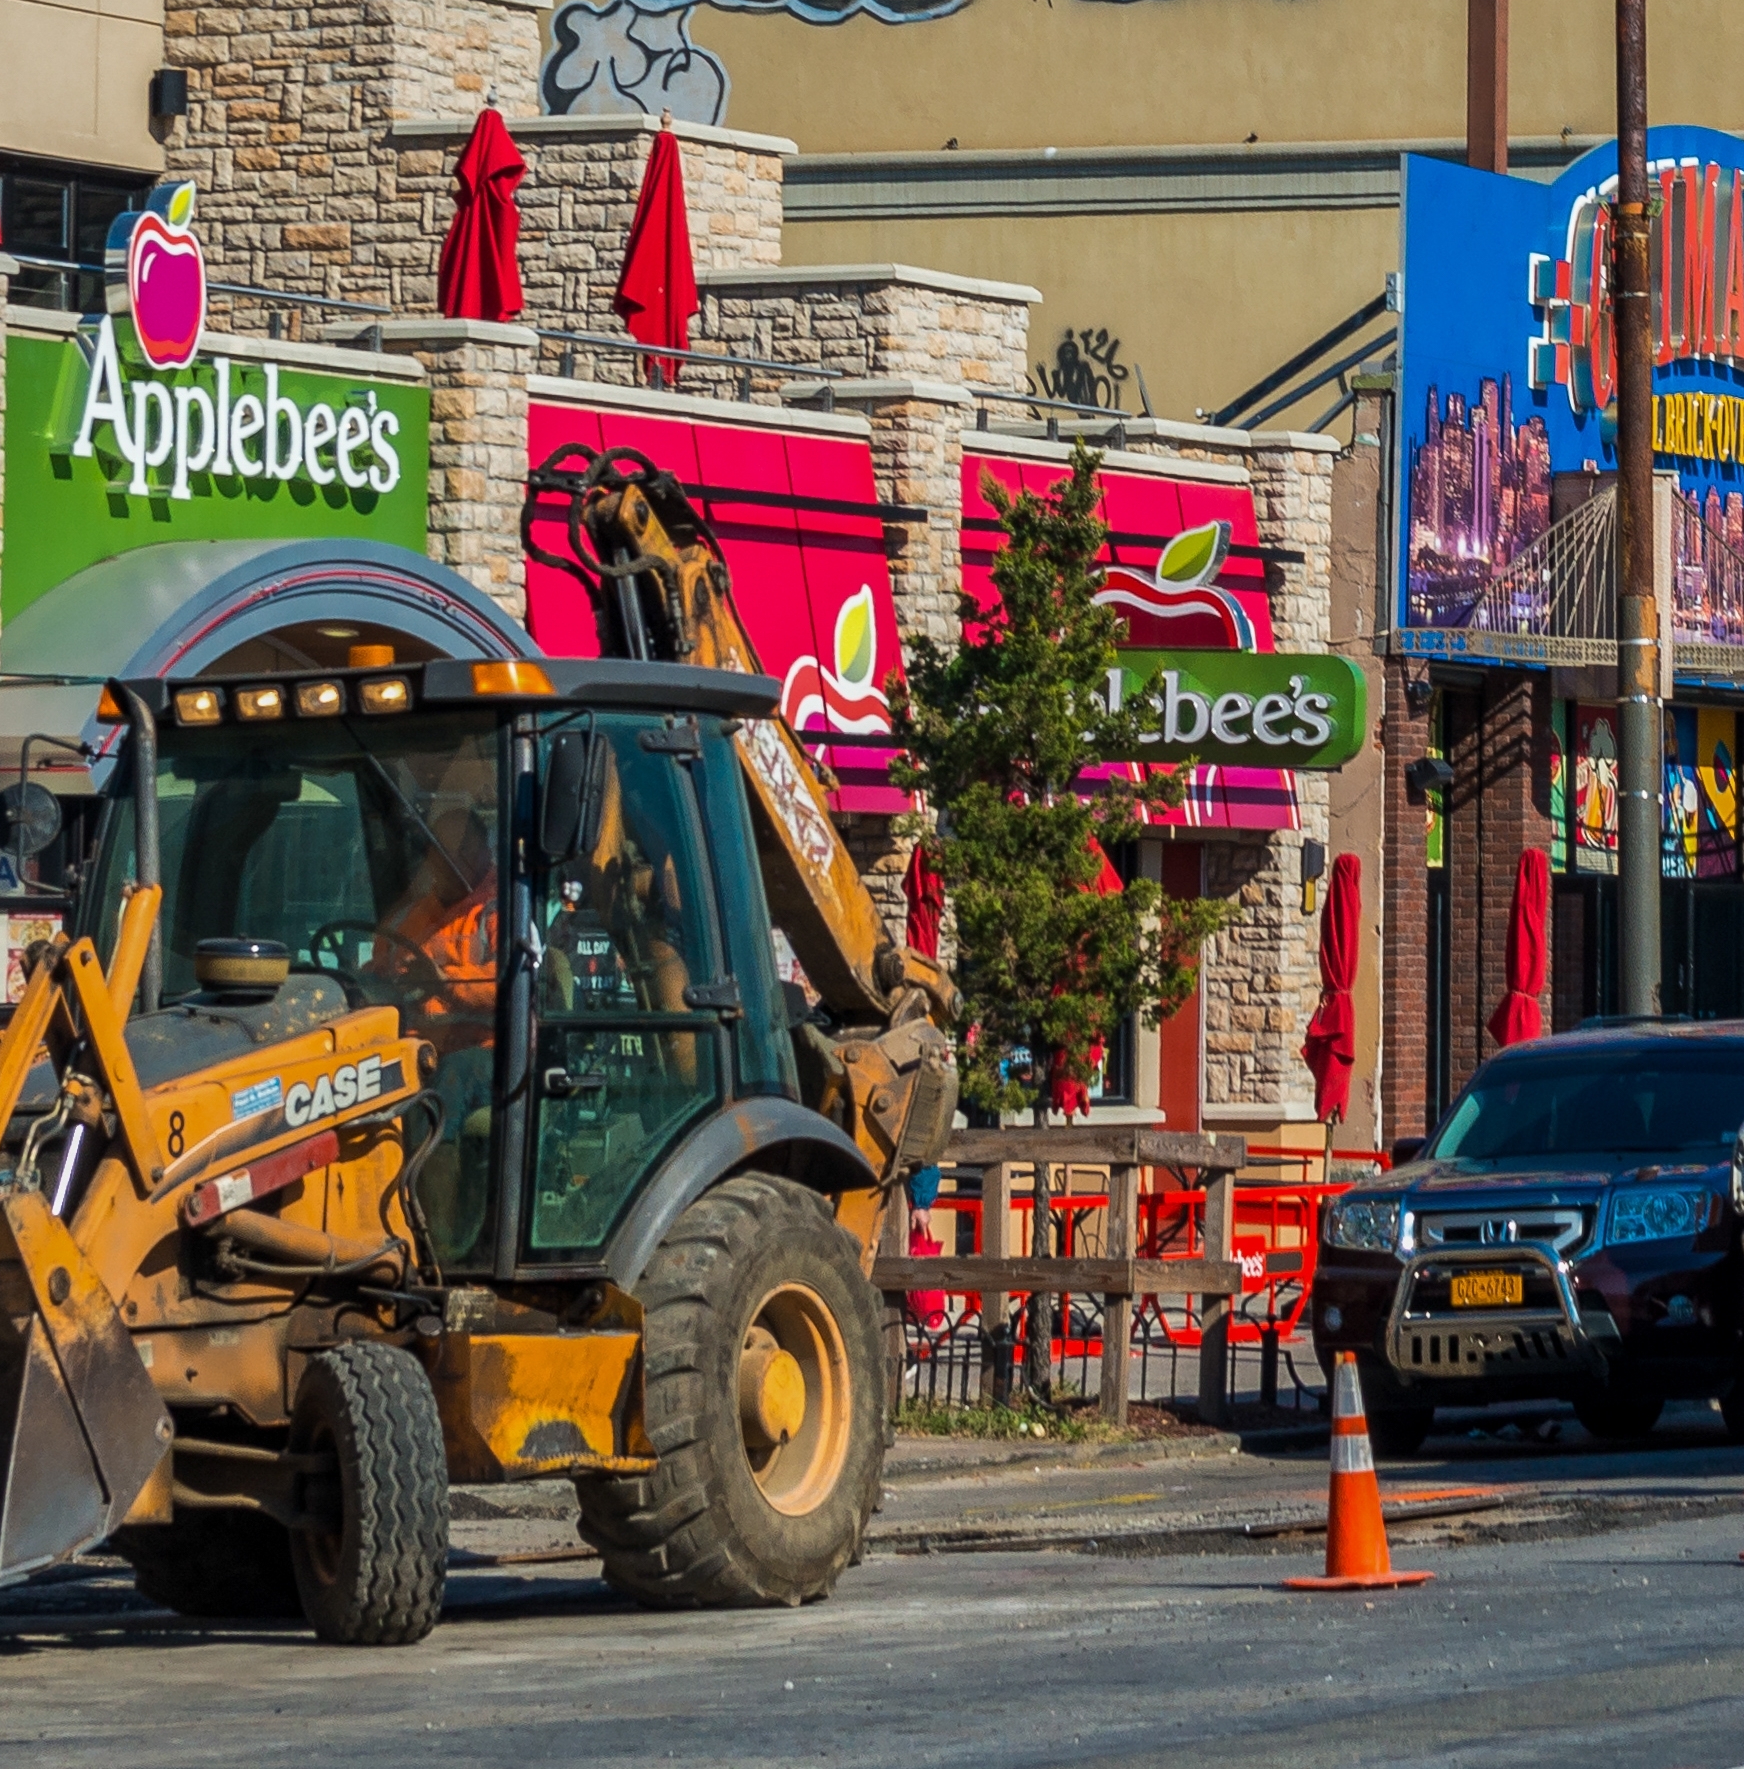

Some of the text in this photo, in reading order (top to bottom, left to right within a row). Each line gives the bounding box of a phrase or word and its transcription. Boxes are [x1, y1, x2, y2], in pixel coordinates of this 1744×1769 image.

[72, 313, 401, 501] Applebee's
[284, 1053, 382, 1128] CASE
[167, 1110, 185, 1159] 8
